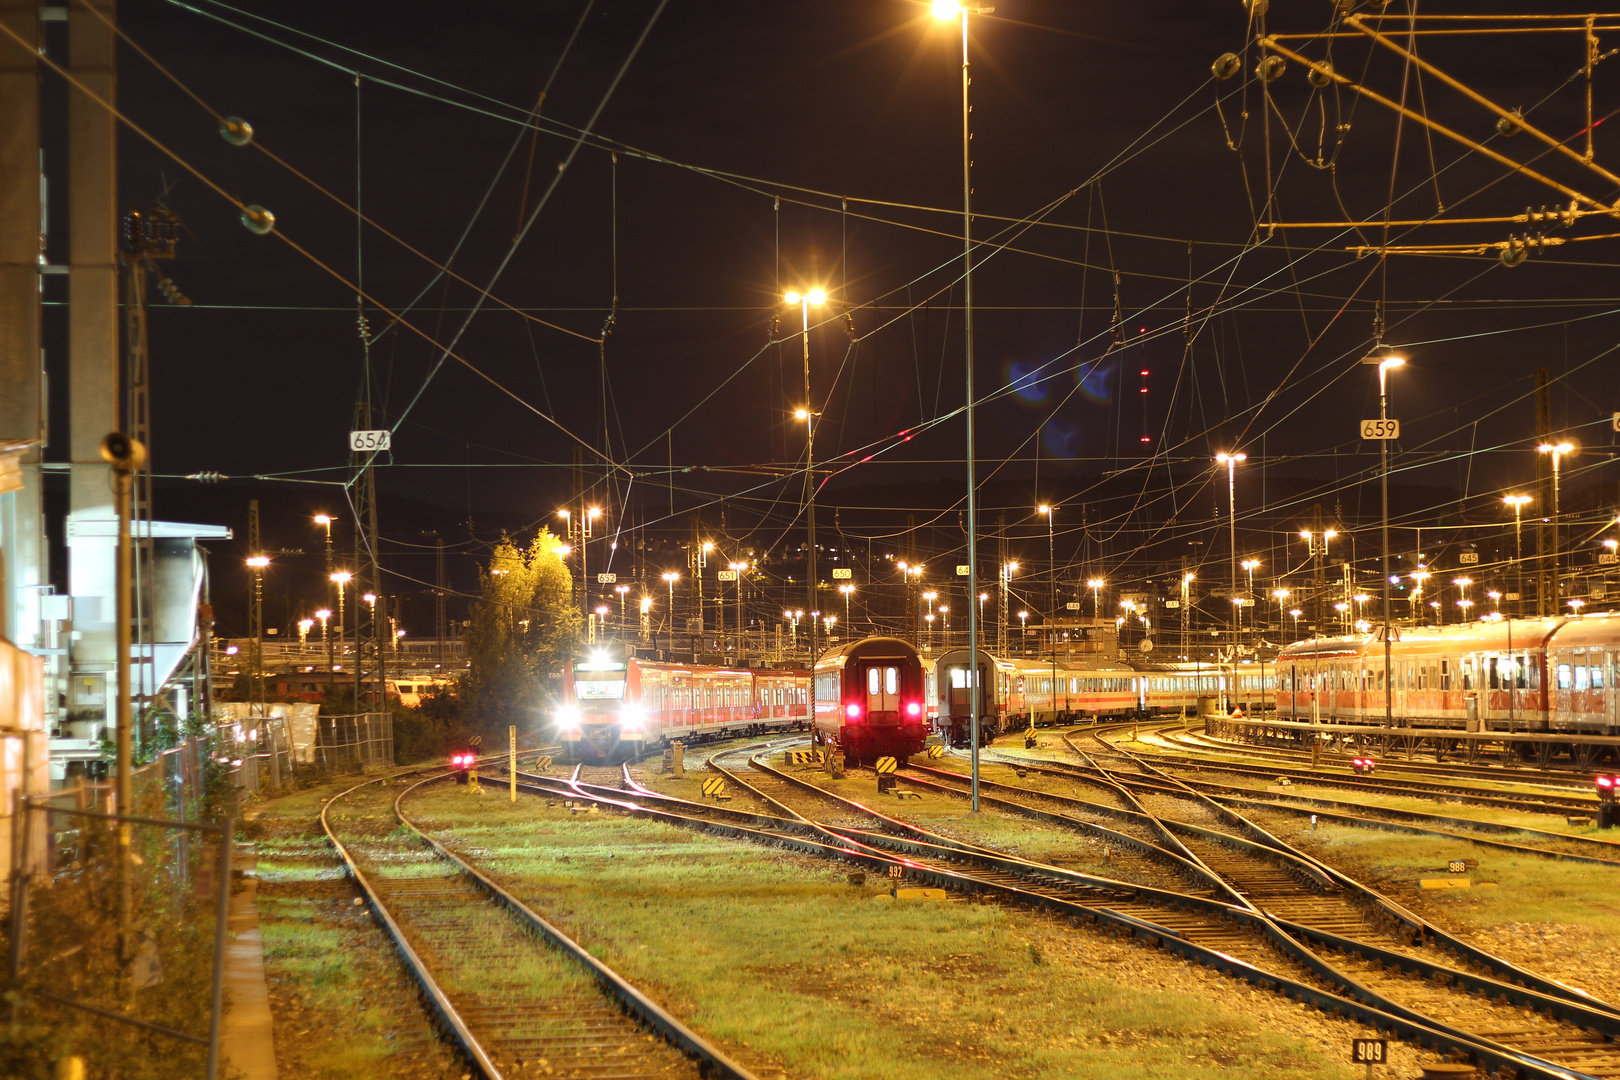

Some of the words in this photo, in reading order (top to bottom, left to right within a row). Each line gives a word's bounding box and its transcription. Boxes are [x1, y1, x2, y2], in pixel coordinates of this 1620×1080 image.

[1363, 421, 1396, 437] 659
[354, 432, 388, 449] 654
[1461, 553, 1478, 562] 645
[1600, 553, 1616, 562] 644
[834, 569, 850, 577] 650
[958, 566, 969, 574] 64
[599, 574, 615, 583] 652
[719, 571, 734, 580] 651
[888, 865, 902, 877] 992
[1449, 862, 1465, 873] 988
[1358, 1042, 1382, 1061] 989
